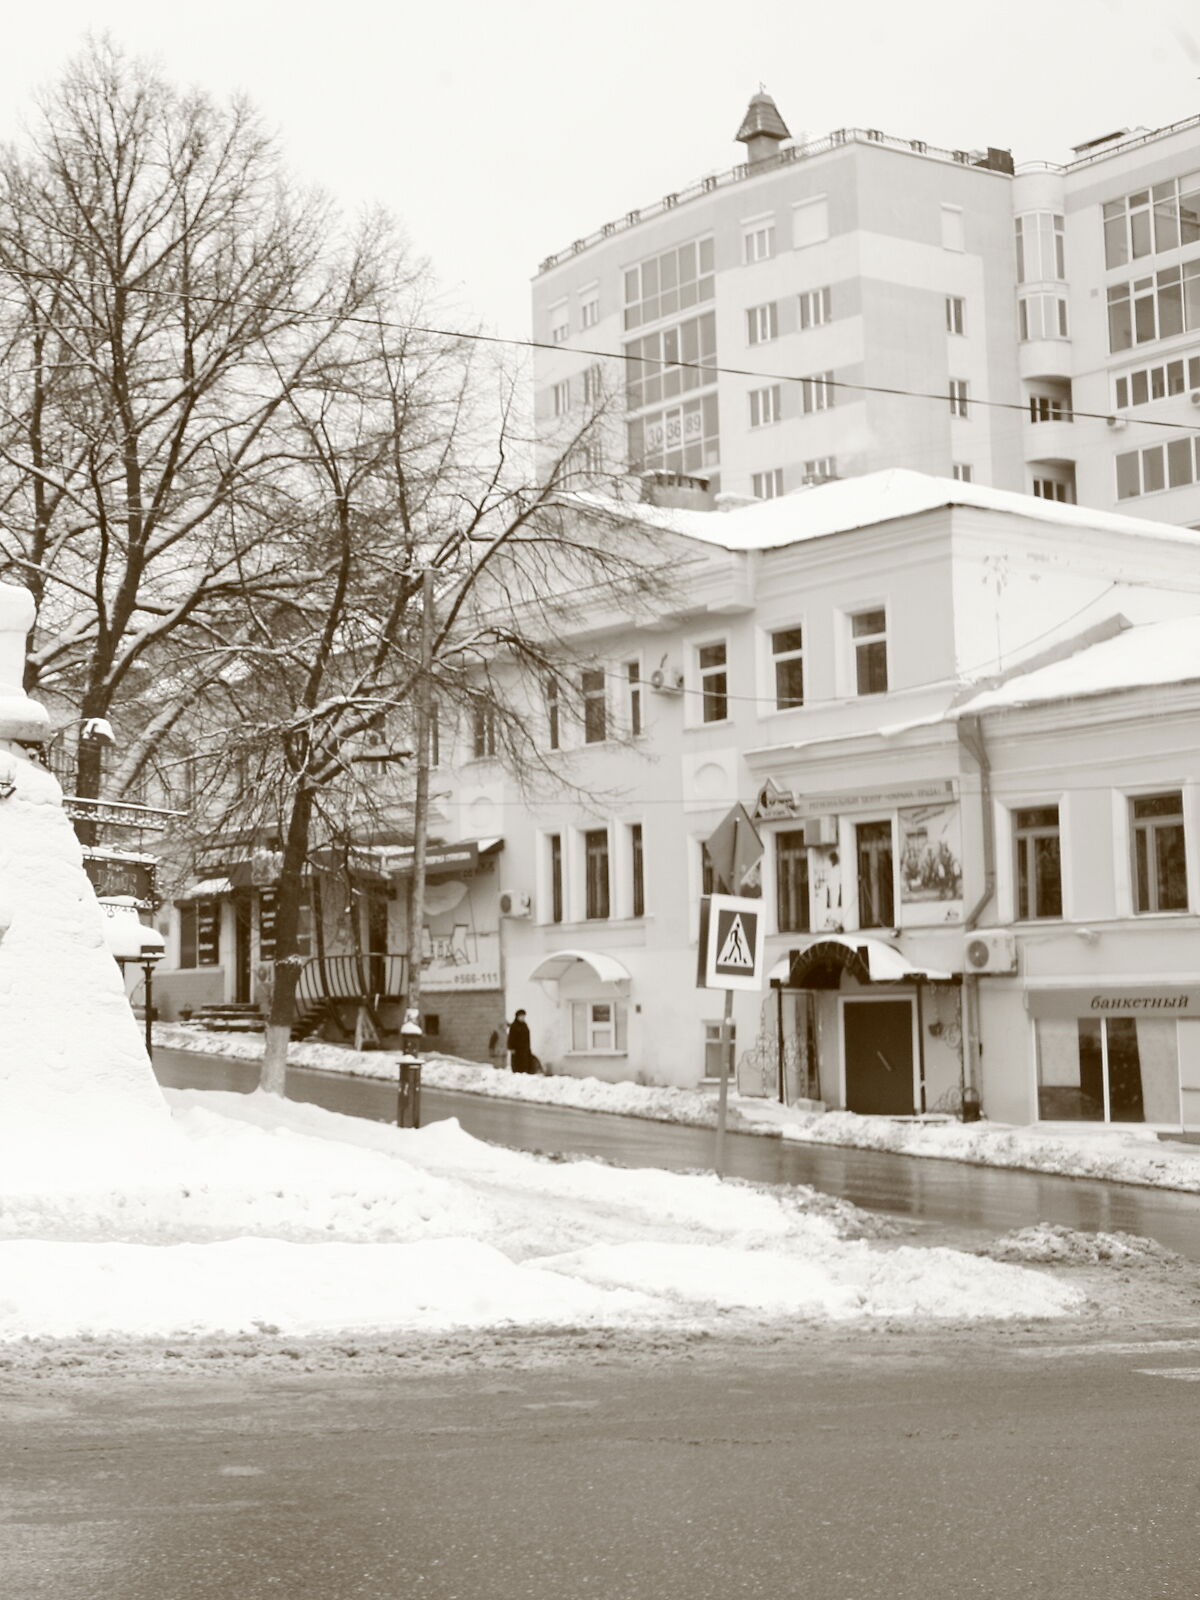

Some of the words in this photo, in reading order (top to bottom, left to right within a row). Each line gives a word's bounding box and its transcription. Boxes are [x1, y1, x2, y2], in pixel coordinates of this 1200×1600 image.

[666, 420, 681, 440] 36
[685, 414, 701, 433] 89
[1090, 994, 1189, 1010] банкетный
